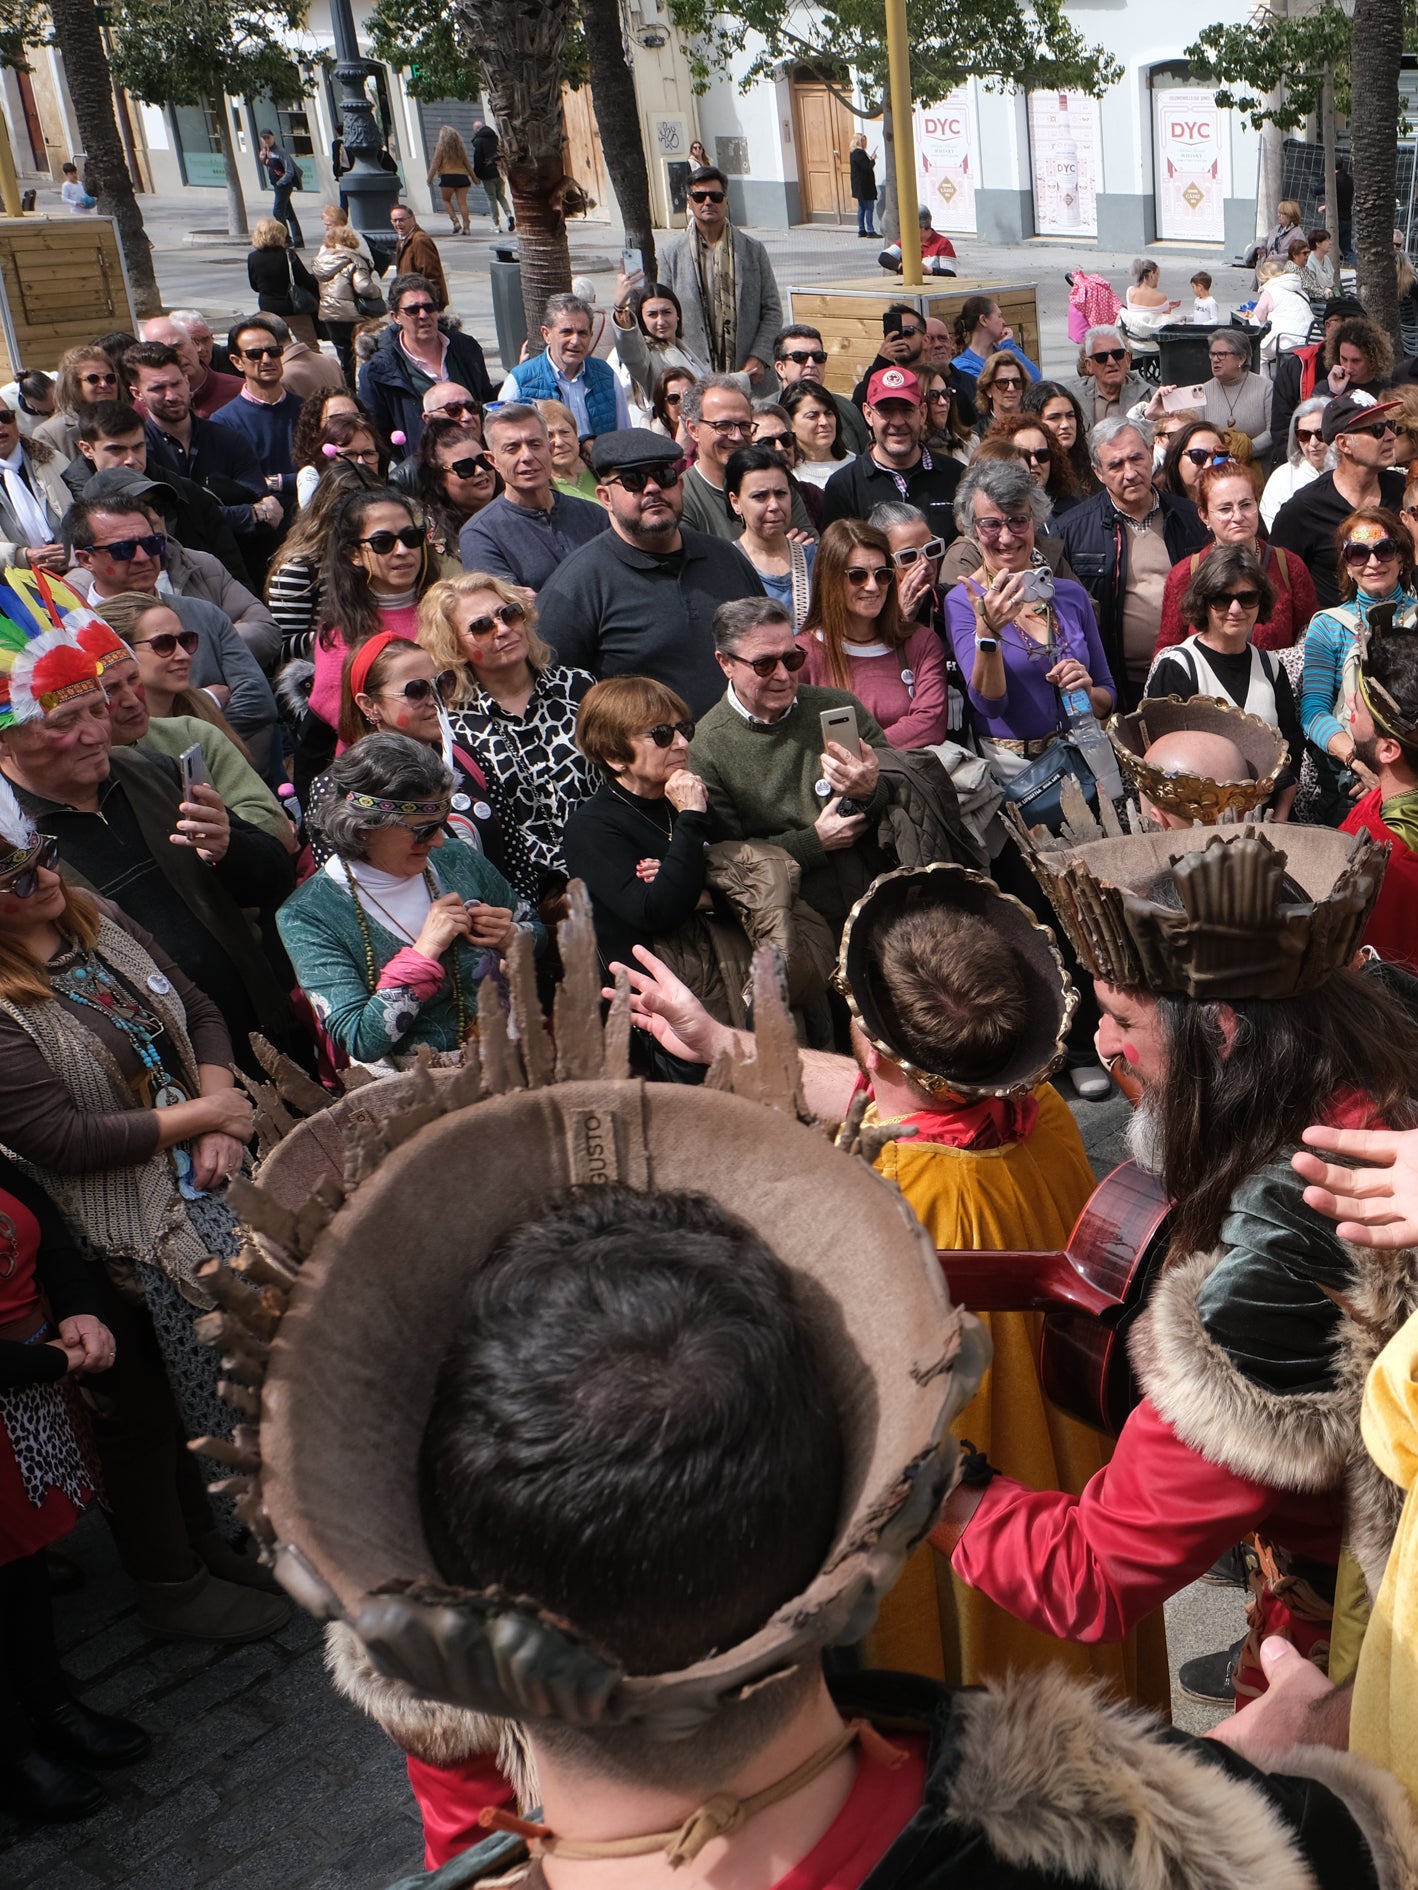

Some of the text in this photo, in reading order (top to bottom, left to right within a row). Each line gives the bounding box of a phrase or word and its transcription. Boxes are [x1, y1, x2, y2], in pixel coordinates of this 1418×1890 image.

[924, 118, 961, 136] DYC
[1171, 121, 1210, 140] DYC
[1057, 163, 1076, 173] DYC
